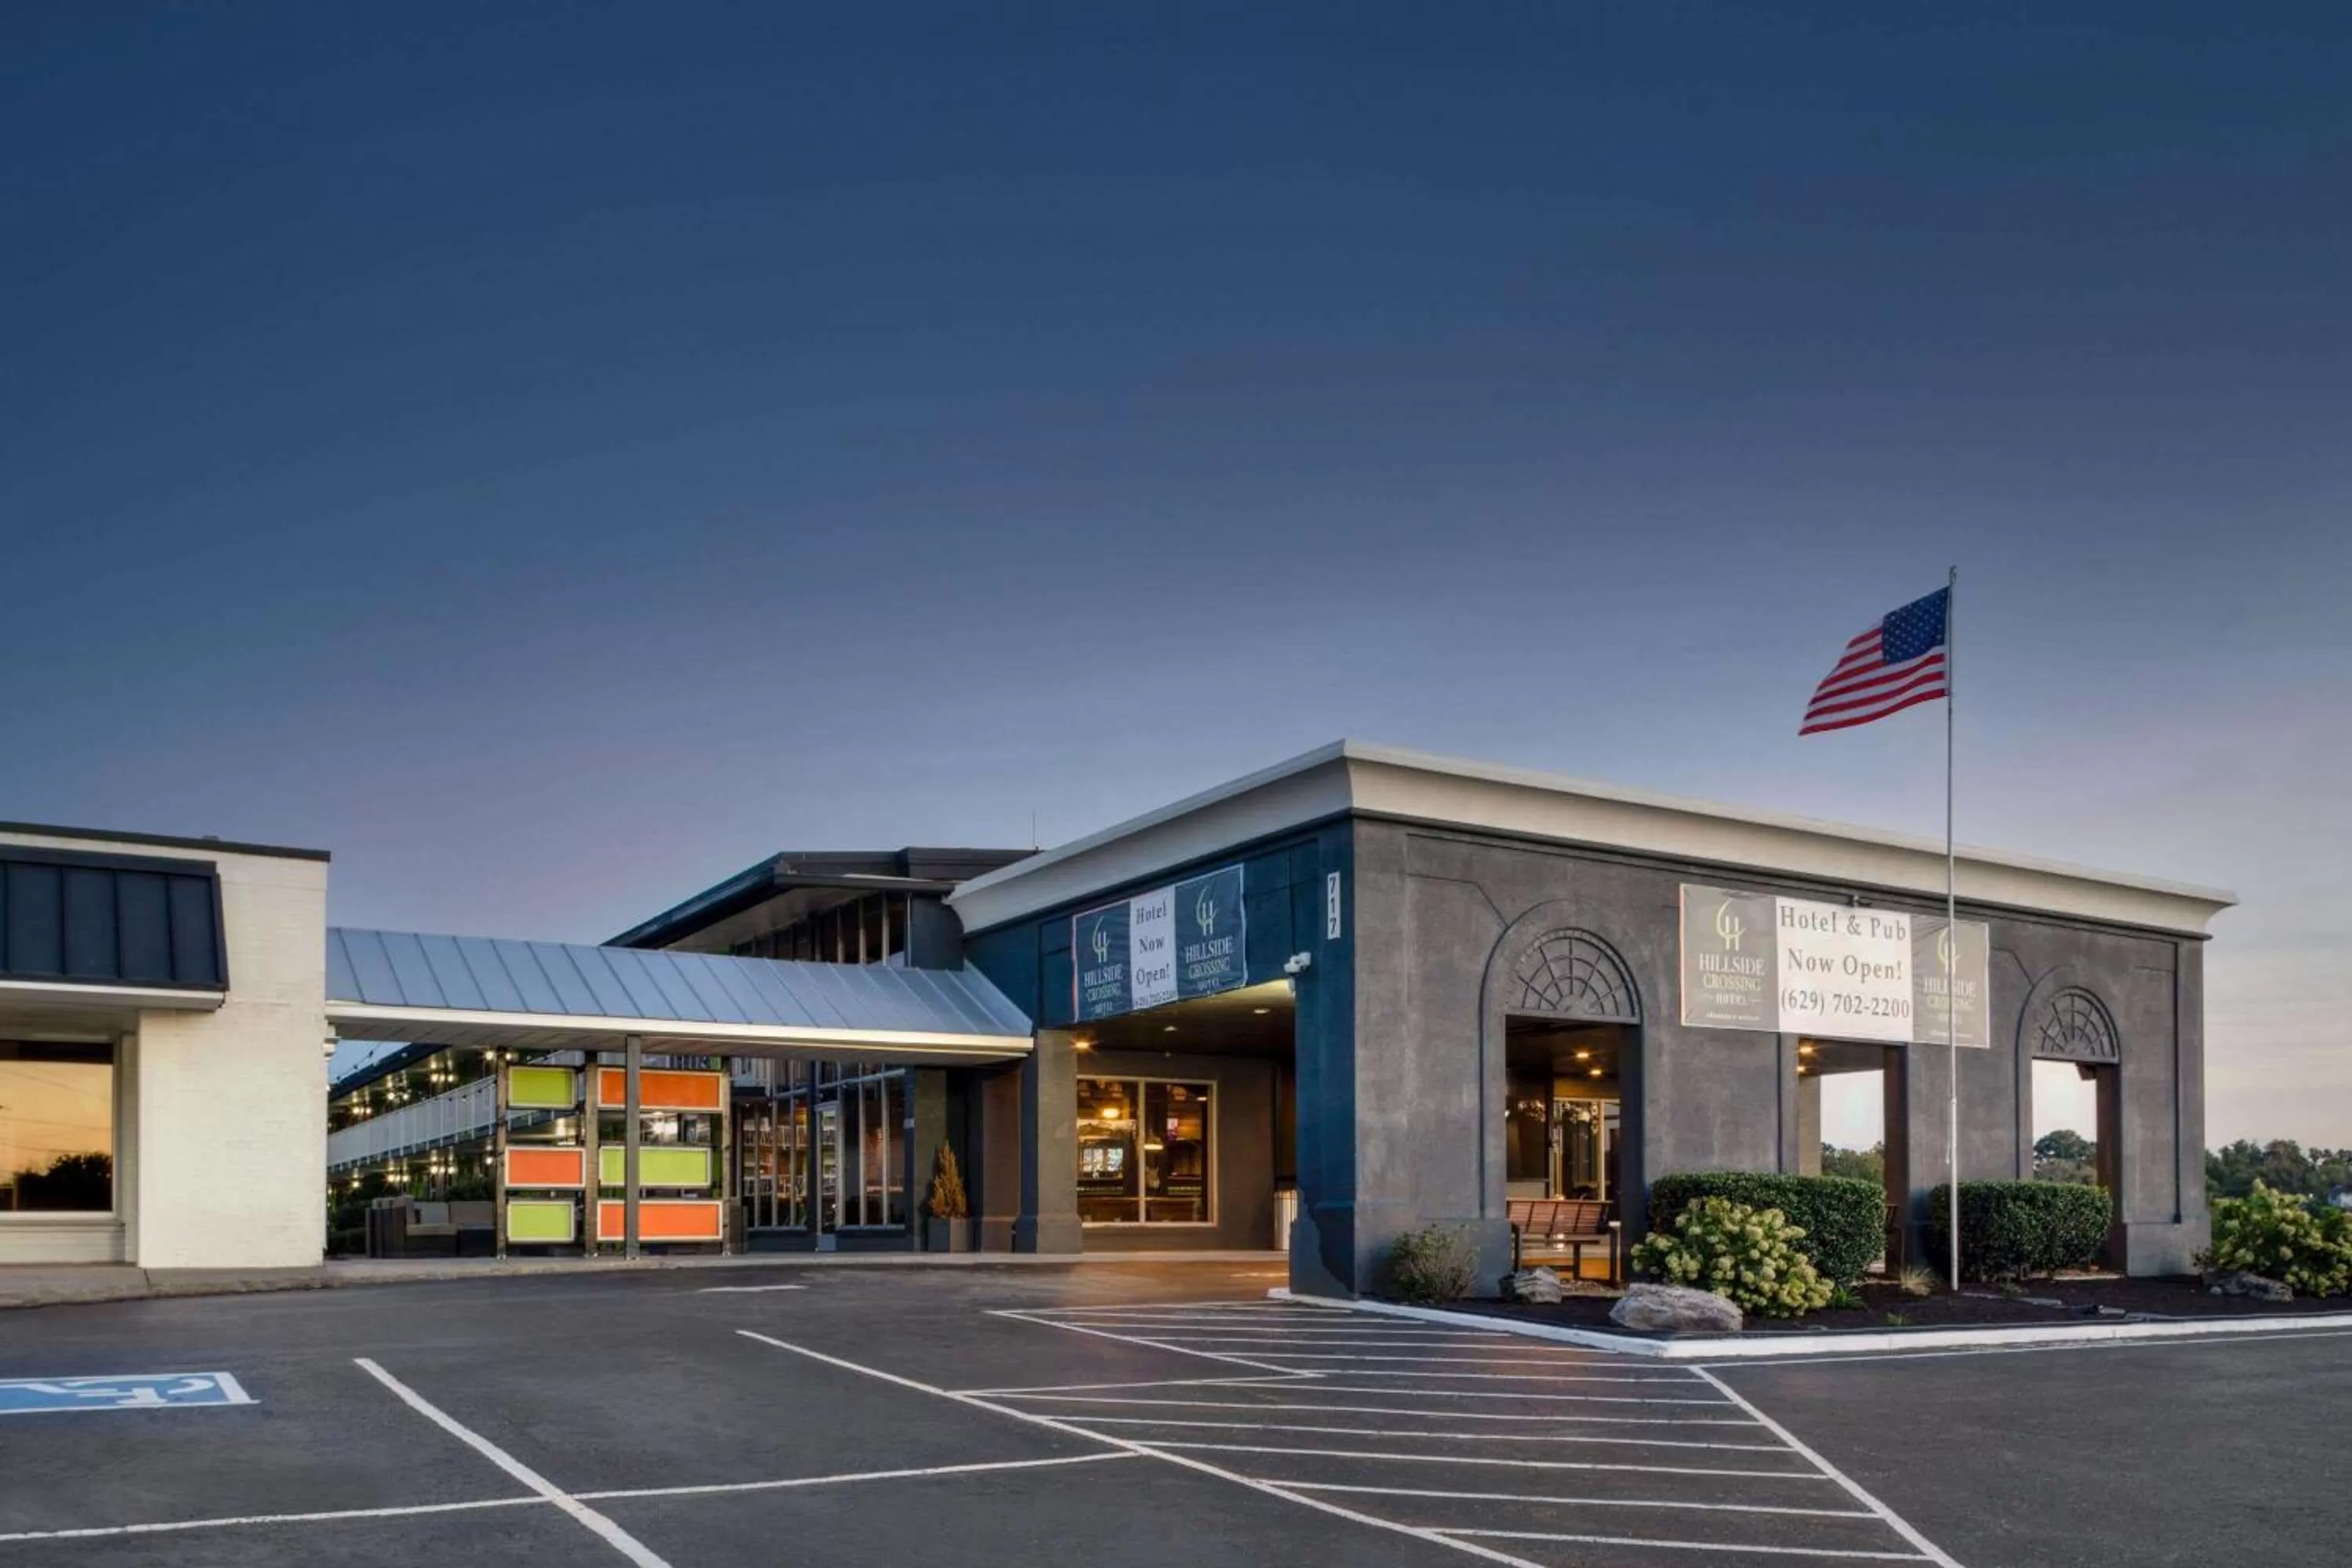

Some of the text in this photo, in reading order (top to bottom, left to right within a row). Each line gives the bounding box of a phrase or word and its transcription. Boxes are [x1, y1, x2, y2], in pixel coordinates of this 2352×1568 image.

[1136, 900, 1167, 925] Hotel
[1329, 877, 1338, 935] 717
[1780, 906, 1907, 942] Hotel & Pub
[1138, 935, 1165, 954] Now
[1185, 935, 1233, 964] HILLSIDE
[1136, 963, 1171, 988] Open!
[1189, 956, 1230, 979] CROSSING
[1699, 953, 1765, 977] HILLSIDE
[1788, 947, 1902, 984] Now Open!
[1703, 971, 1762, 993] CROSSING
[1780, 988, 1824, 1016] (629)
[1832, 993, 1910, 1018] 702-2200
